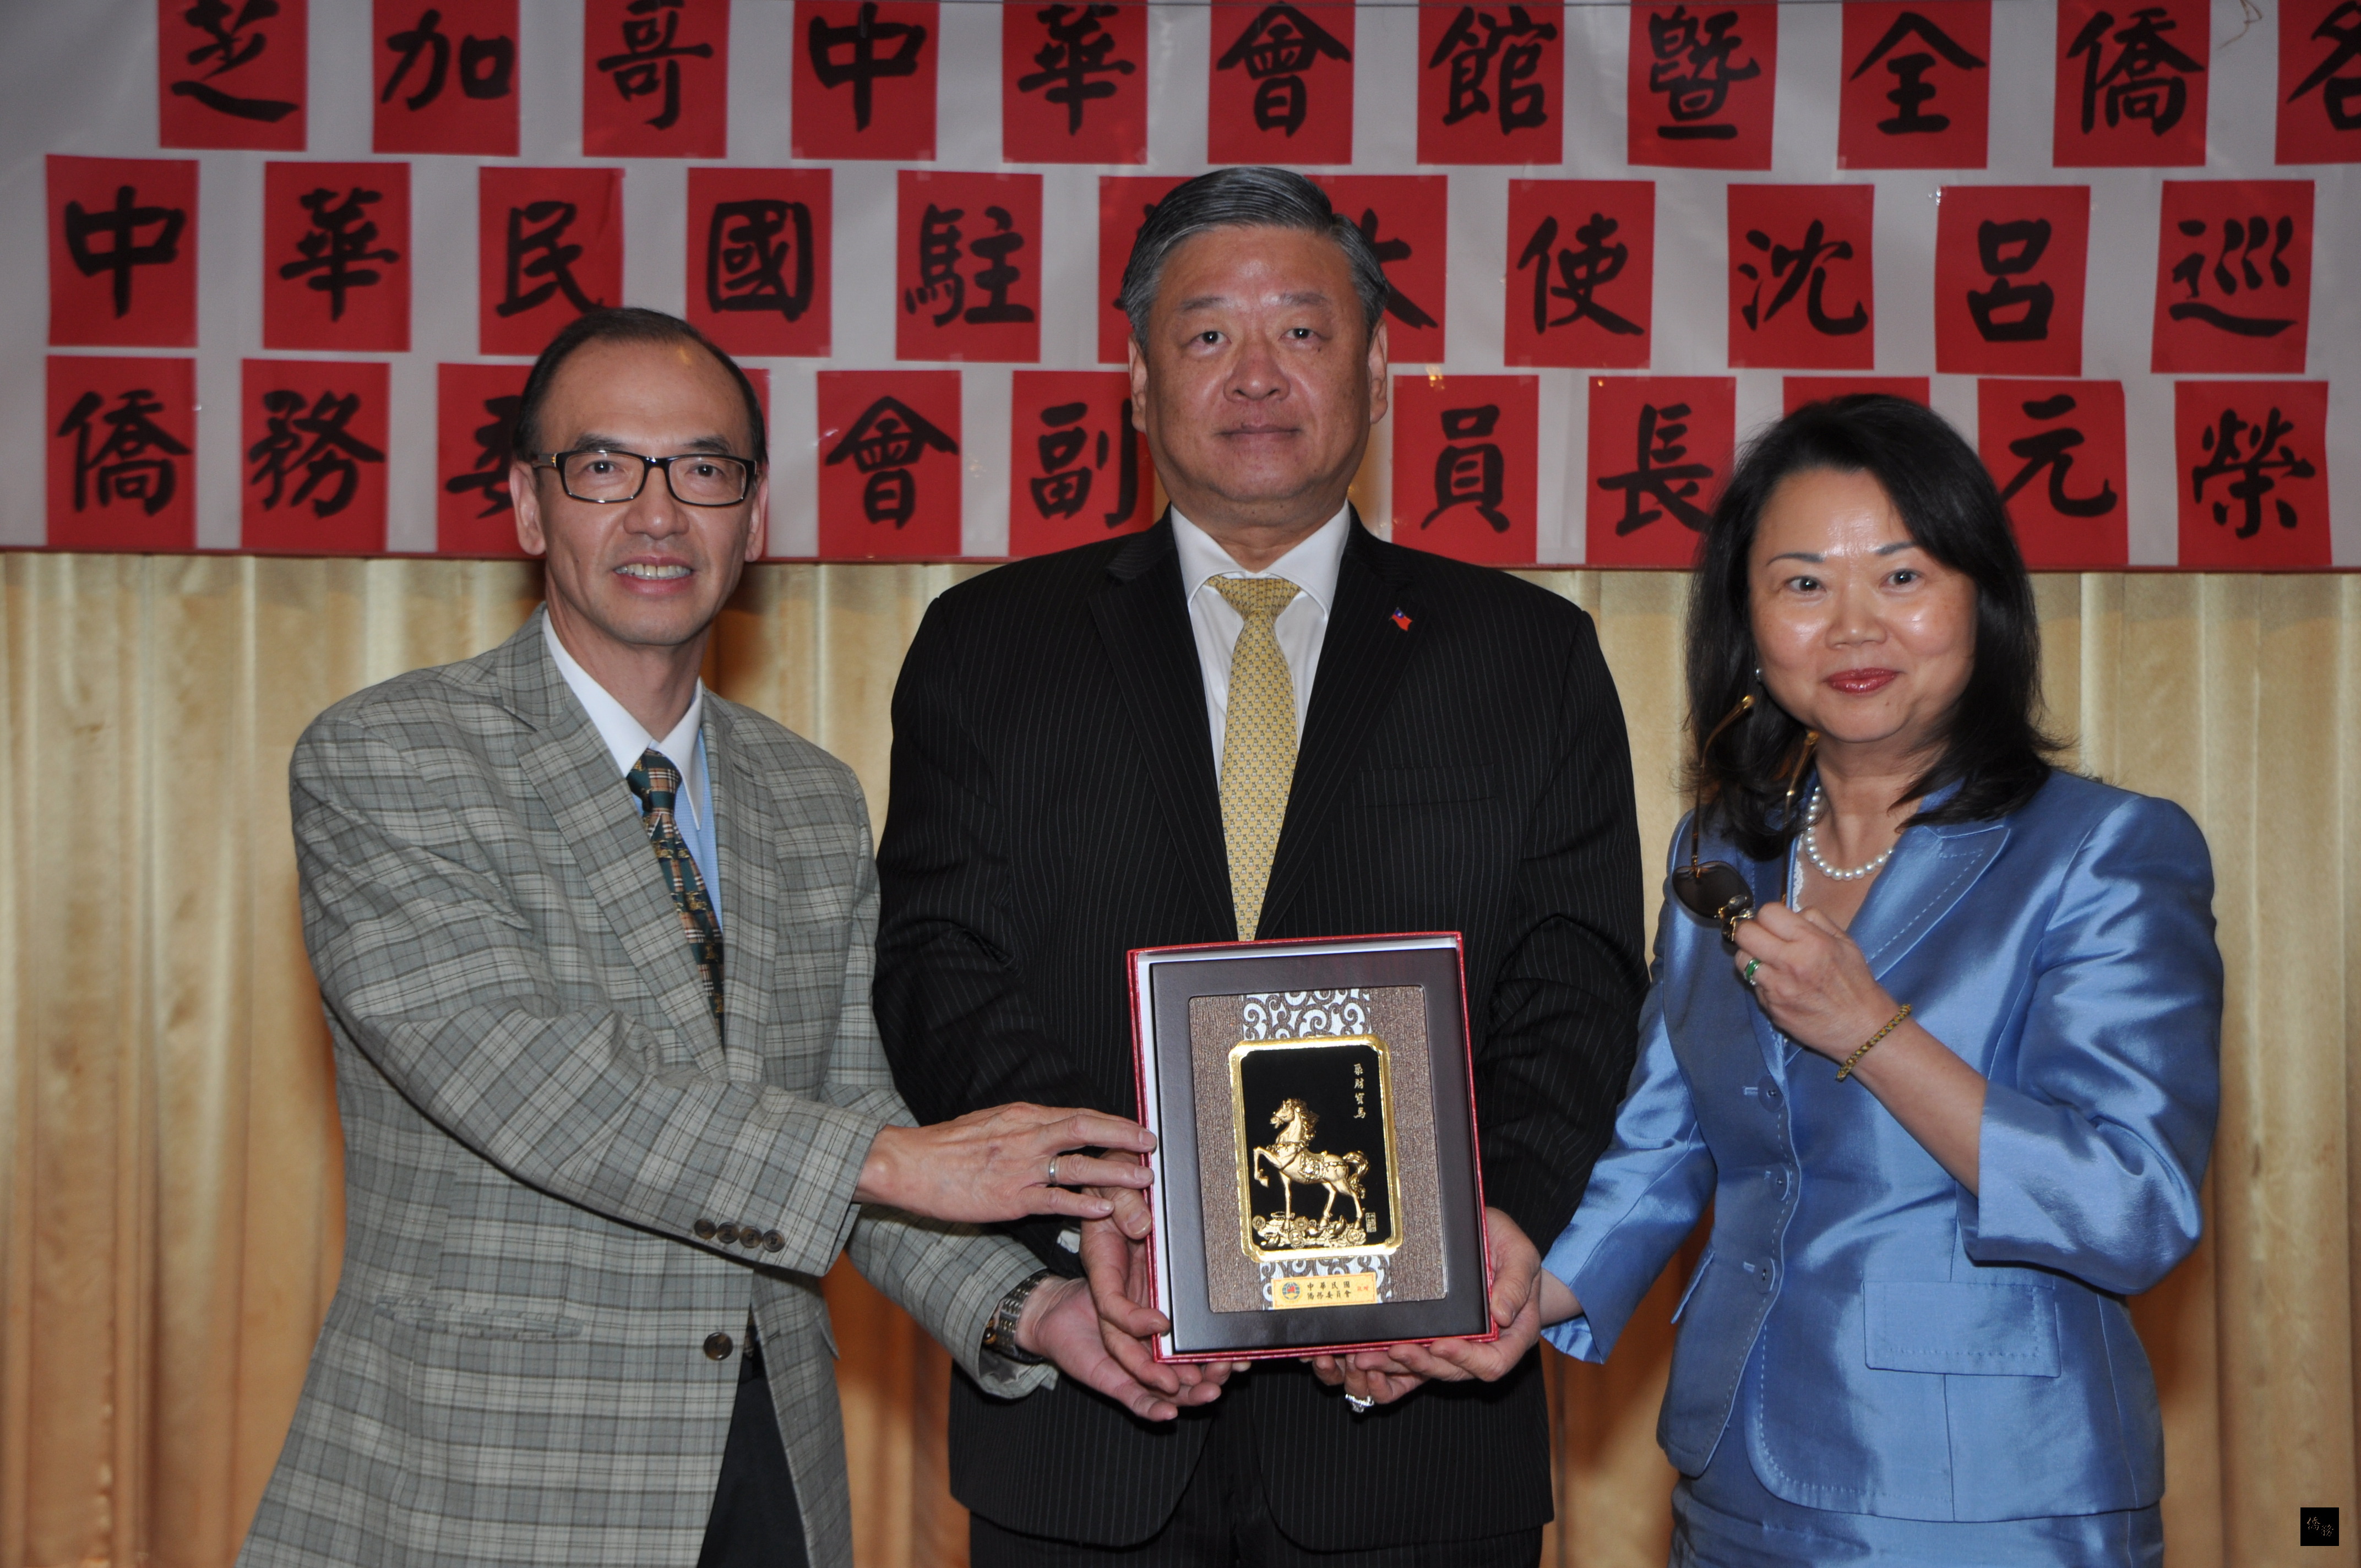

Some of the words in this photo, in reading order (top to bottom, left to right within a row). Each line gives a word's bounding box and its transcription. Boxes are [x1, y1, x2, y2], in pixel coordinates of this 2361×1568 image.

[64, 185, 2298, 342] 中華民國駐使沈呂巡
[1307, 1281, 1350, 1291] 中華民國
[1307, 1289, 1352, 1300] 僑務委員會
